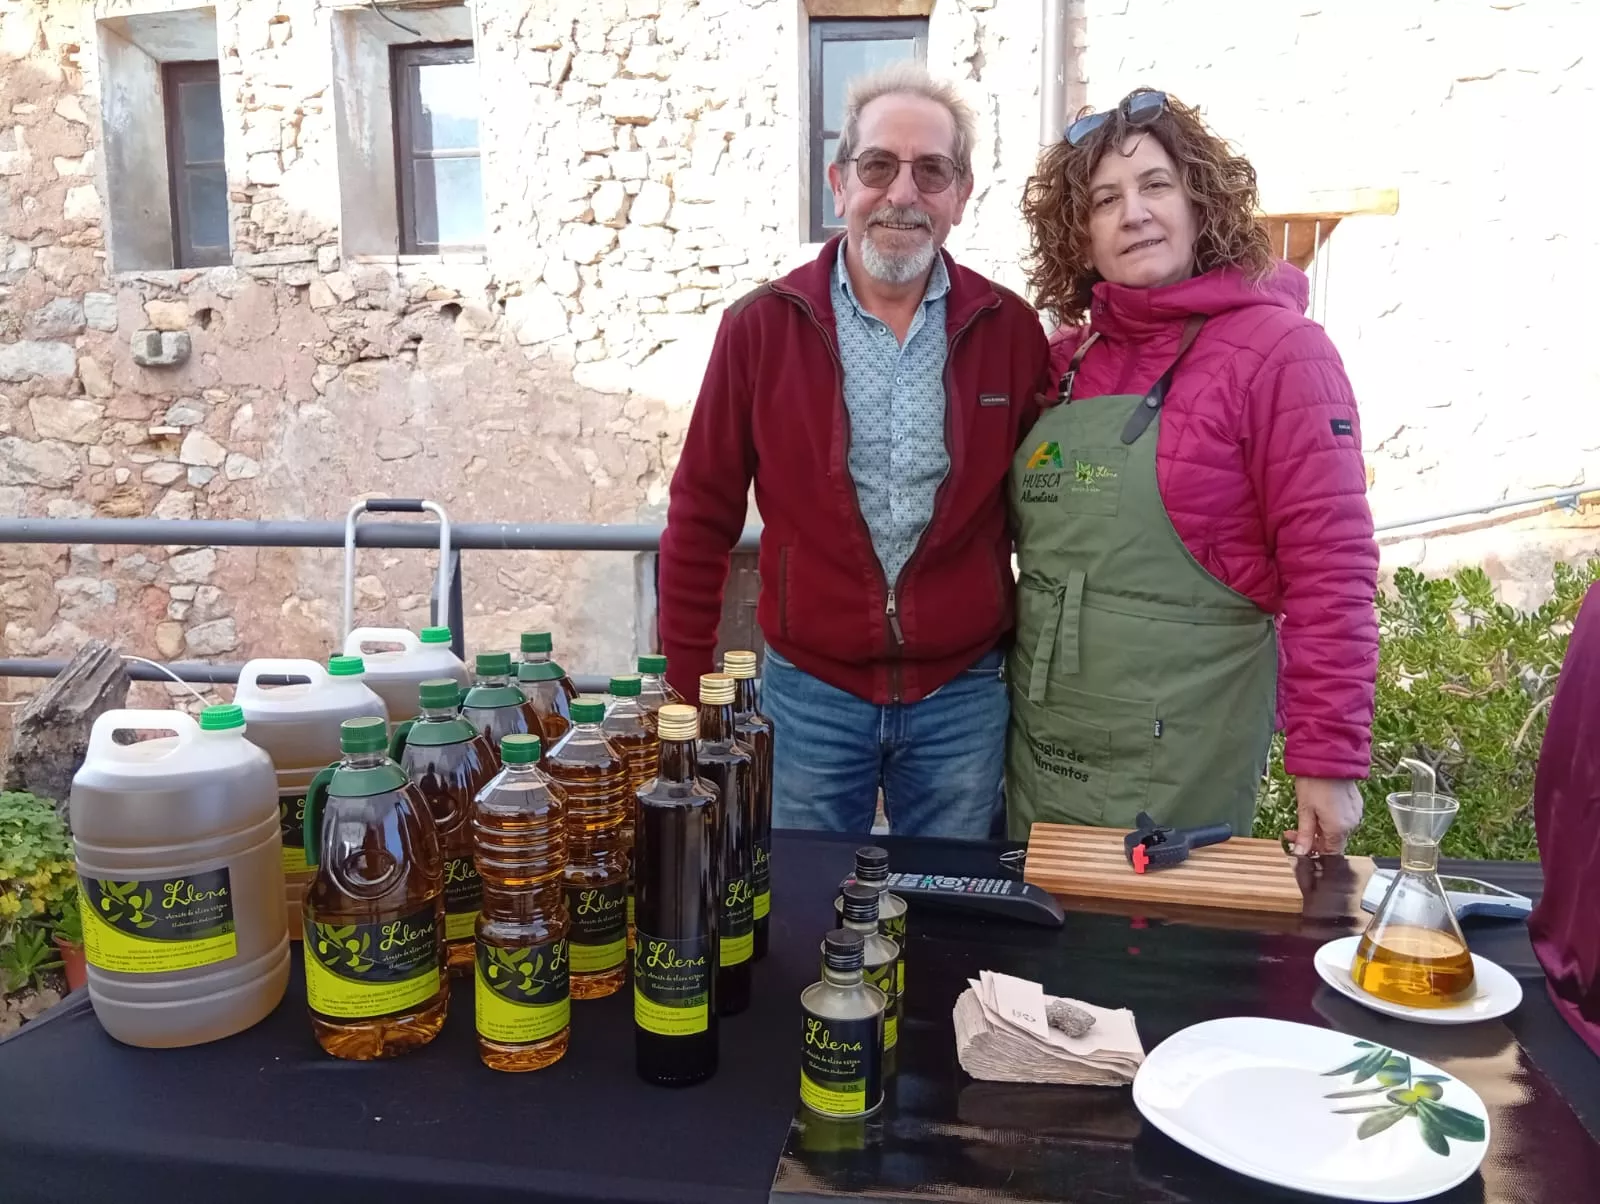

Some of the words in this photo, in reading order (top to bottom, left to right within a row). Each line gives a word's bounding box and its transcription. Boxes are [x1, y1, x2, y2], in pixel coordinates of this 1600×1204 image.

[1022, 473, 1061, 488] HUESCA
[1020, 490, 1058, 503] Alimentaria
[1036, 741, 1065, 757] agia
[1067, 749, 1085, 763] de
[1034, 753, 1089, 783] limentos
[162, 880, 228, 908] Llena
[380, 920, 434, 951] Llena
[646, 941, 706, 969] Llena
[806, 1018, 863, 1053] Llena
